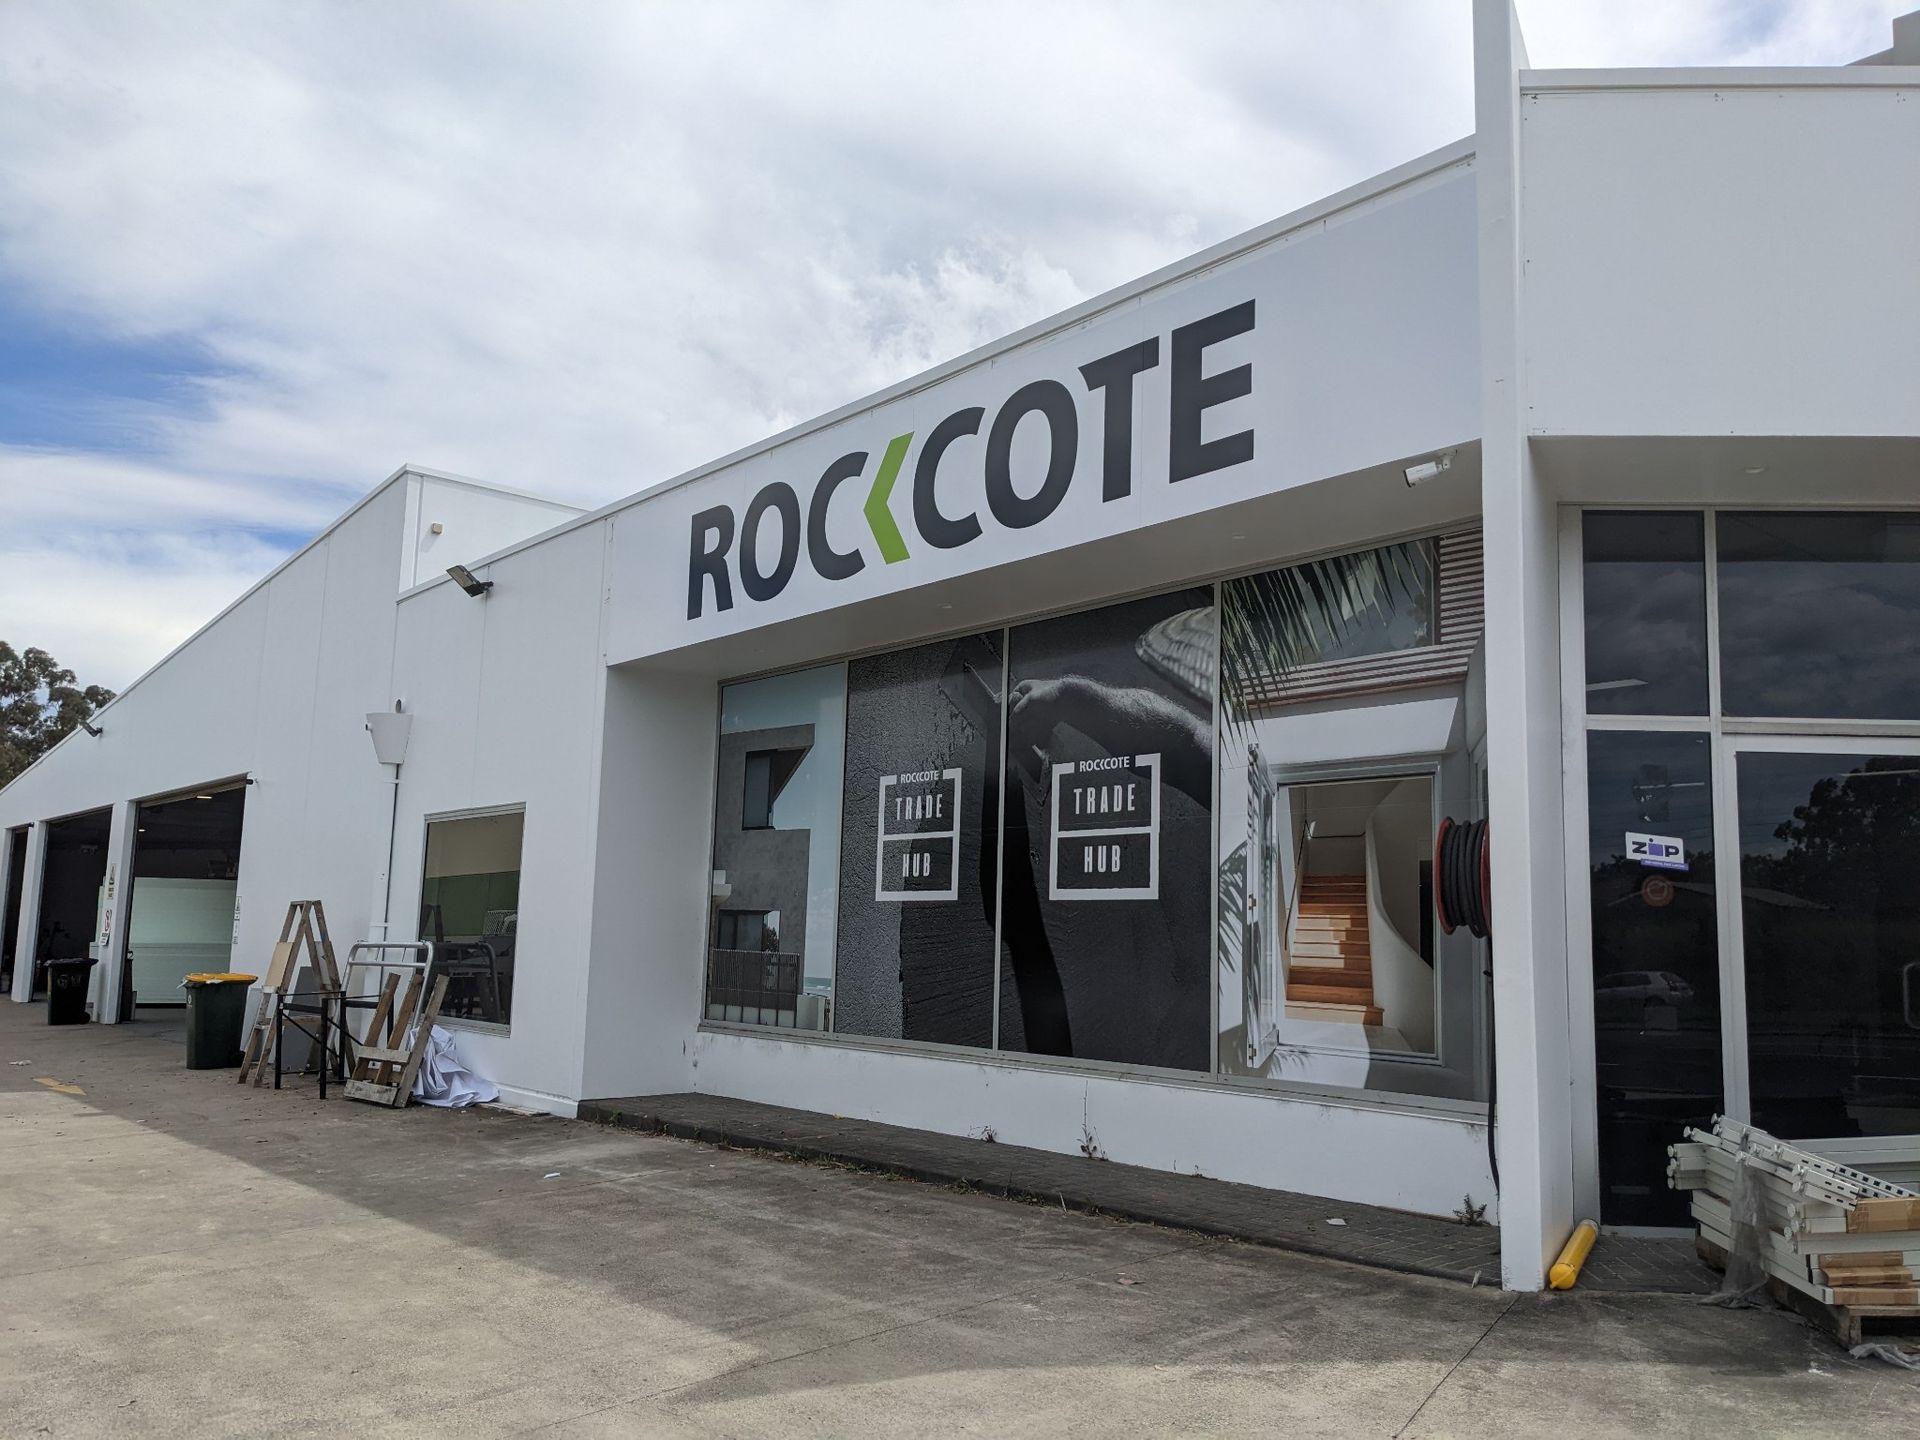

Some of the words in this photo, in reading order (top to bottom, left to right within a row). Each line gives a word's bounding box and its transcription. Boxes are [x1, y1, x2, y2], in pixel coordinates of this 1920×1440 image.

[895, 794, 943, 820] TRADE
[1073, 783, 1136, 815] TRADE
[902, 852, 931, 878] HUB
[1084, 845, 1121, 873] HUB
